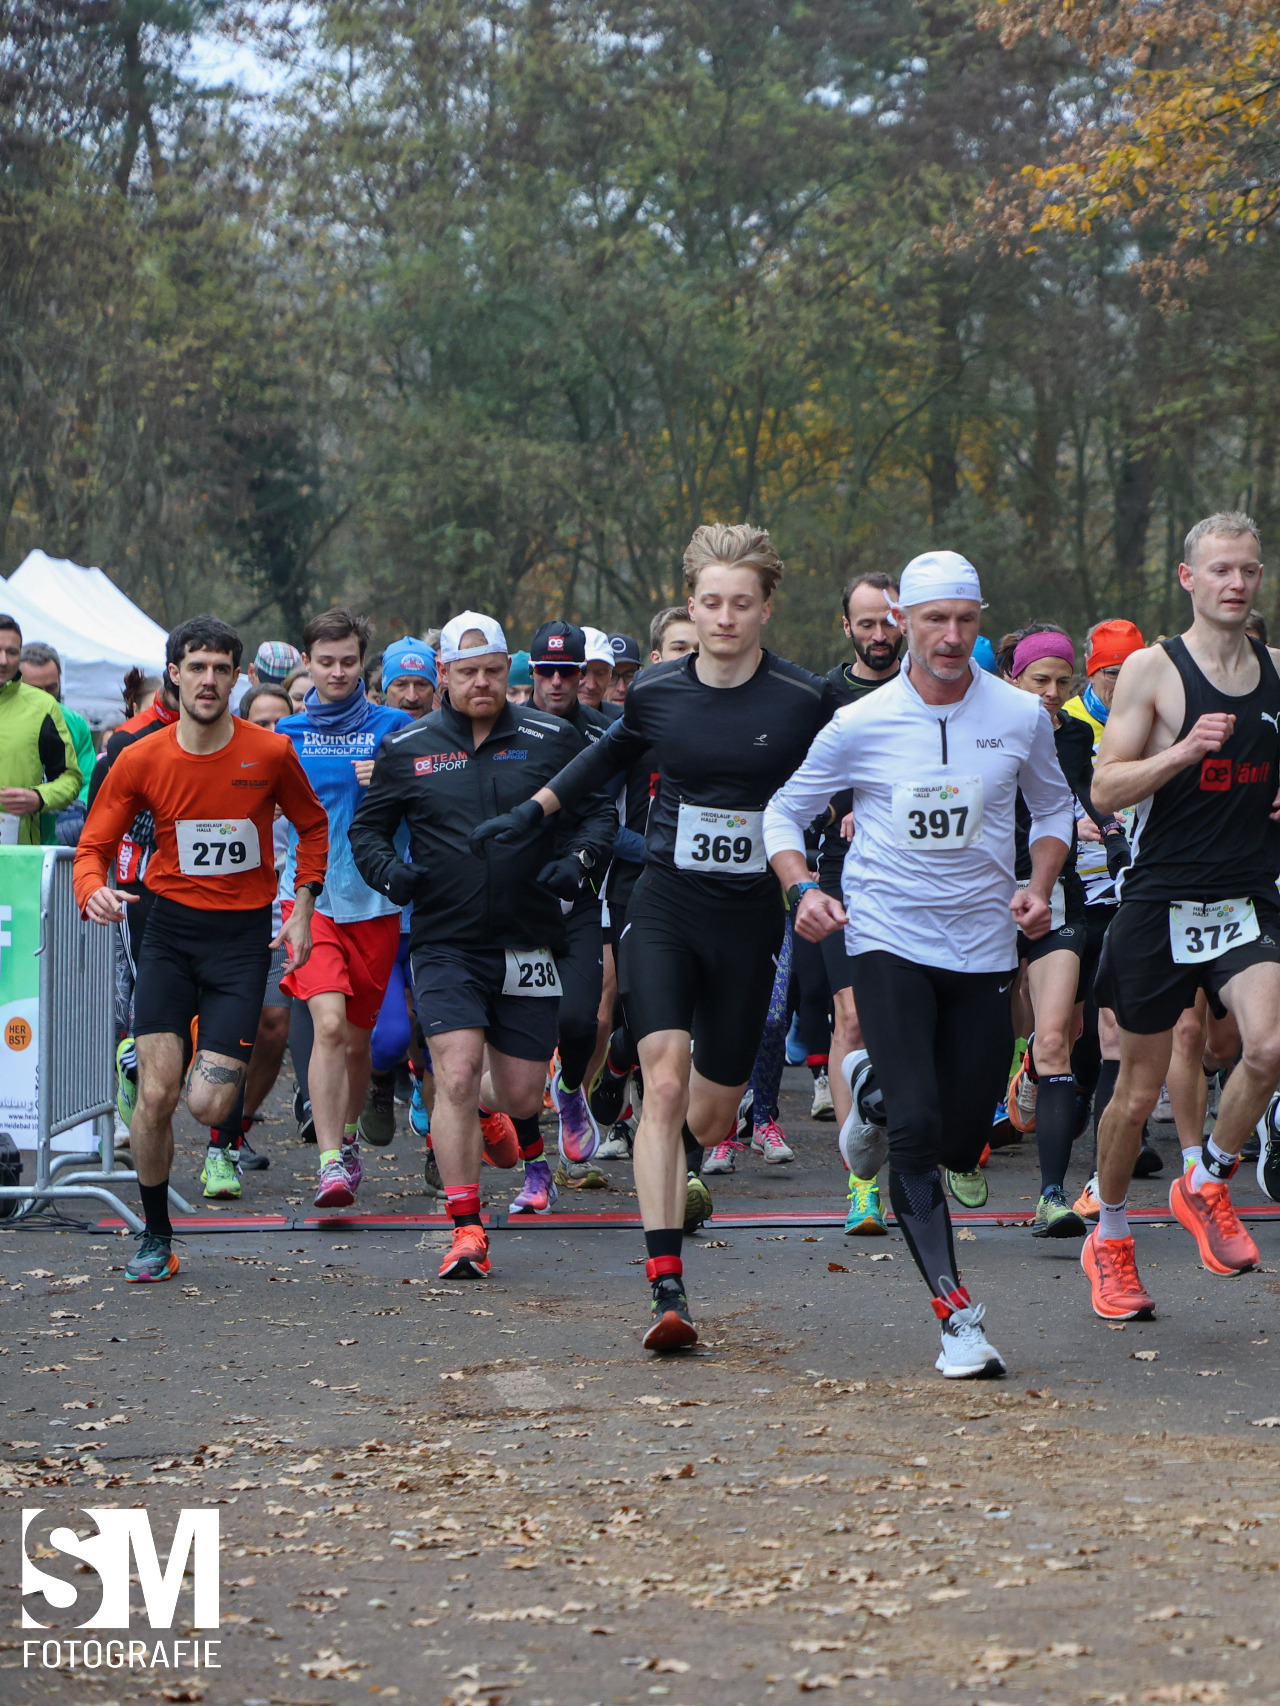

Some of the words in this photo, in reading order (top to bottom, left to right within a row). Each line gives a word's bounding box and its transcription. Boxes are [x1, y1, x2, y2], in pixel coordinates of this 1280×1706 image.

[302, 730, 376, 747] ERDINGER
[517, 725, 545, 740] FUSION
[976, 738, 1004, 749] NASA
[432, 750, 468, 763] TEAM
[432, 759, 468, 773] SPORT
[700, 811, 732, 820] HEIDELAUF
[908, 805, 969, 839] 397
[192, 841, 247, 866] 279
[691, 833, 753, 864] 369
[119, 843, 133, 880] CAISSE
[1185, 922, 1243, 954] 372
[517, 961, 557, 988] 238
[9, 1025, 26, 1035] HER
[8, 1035, 27, 1046] BST
